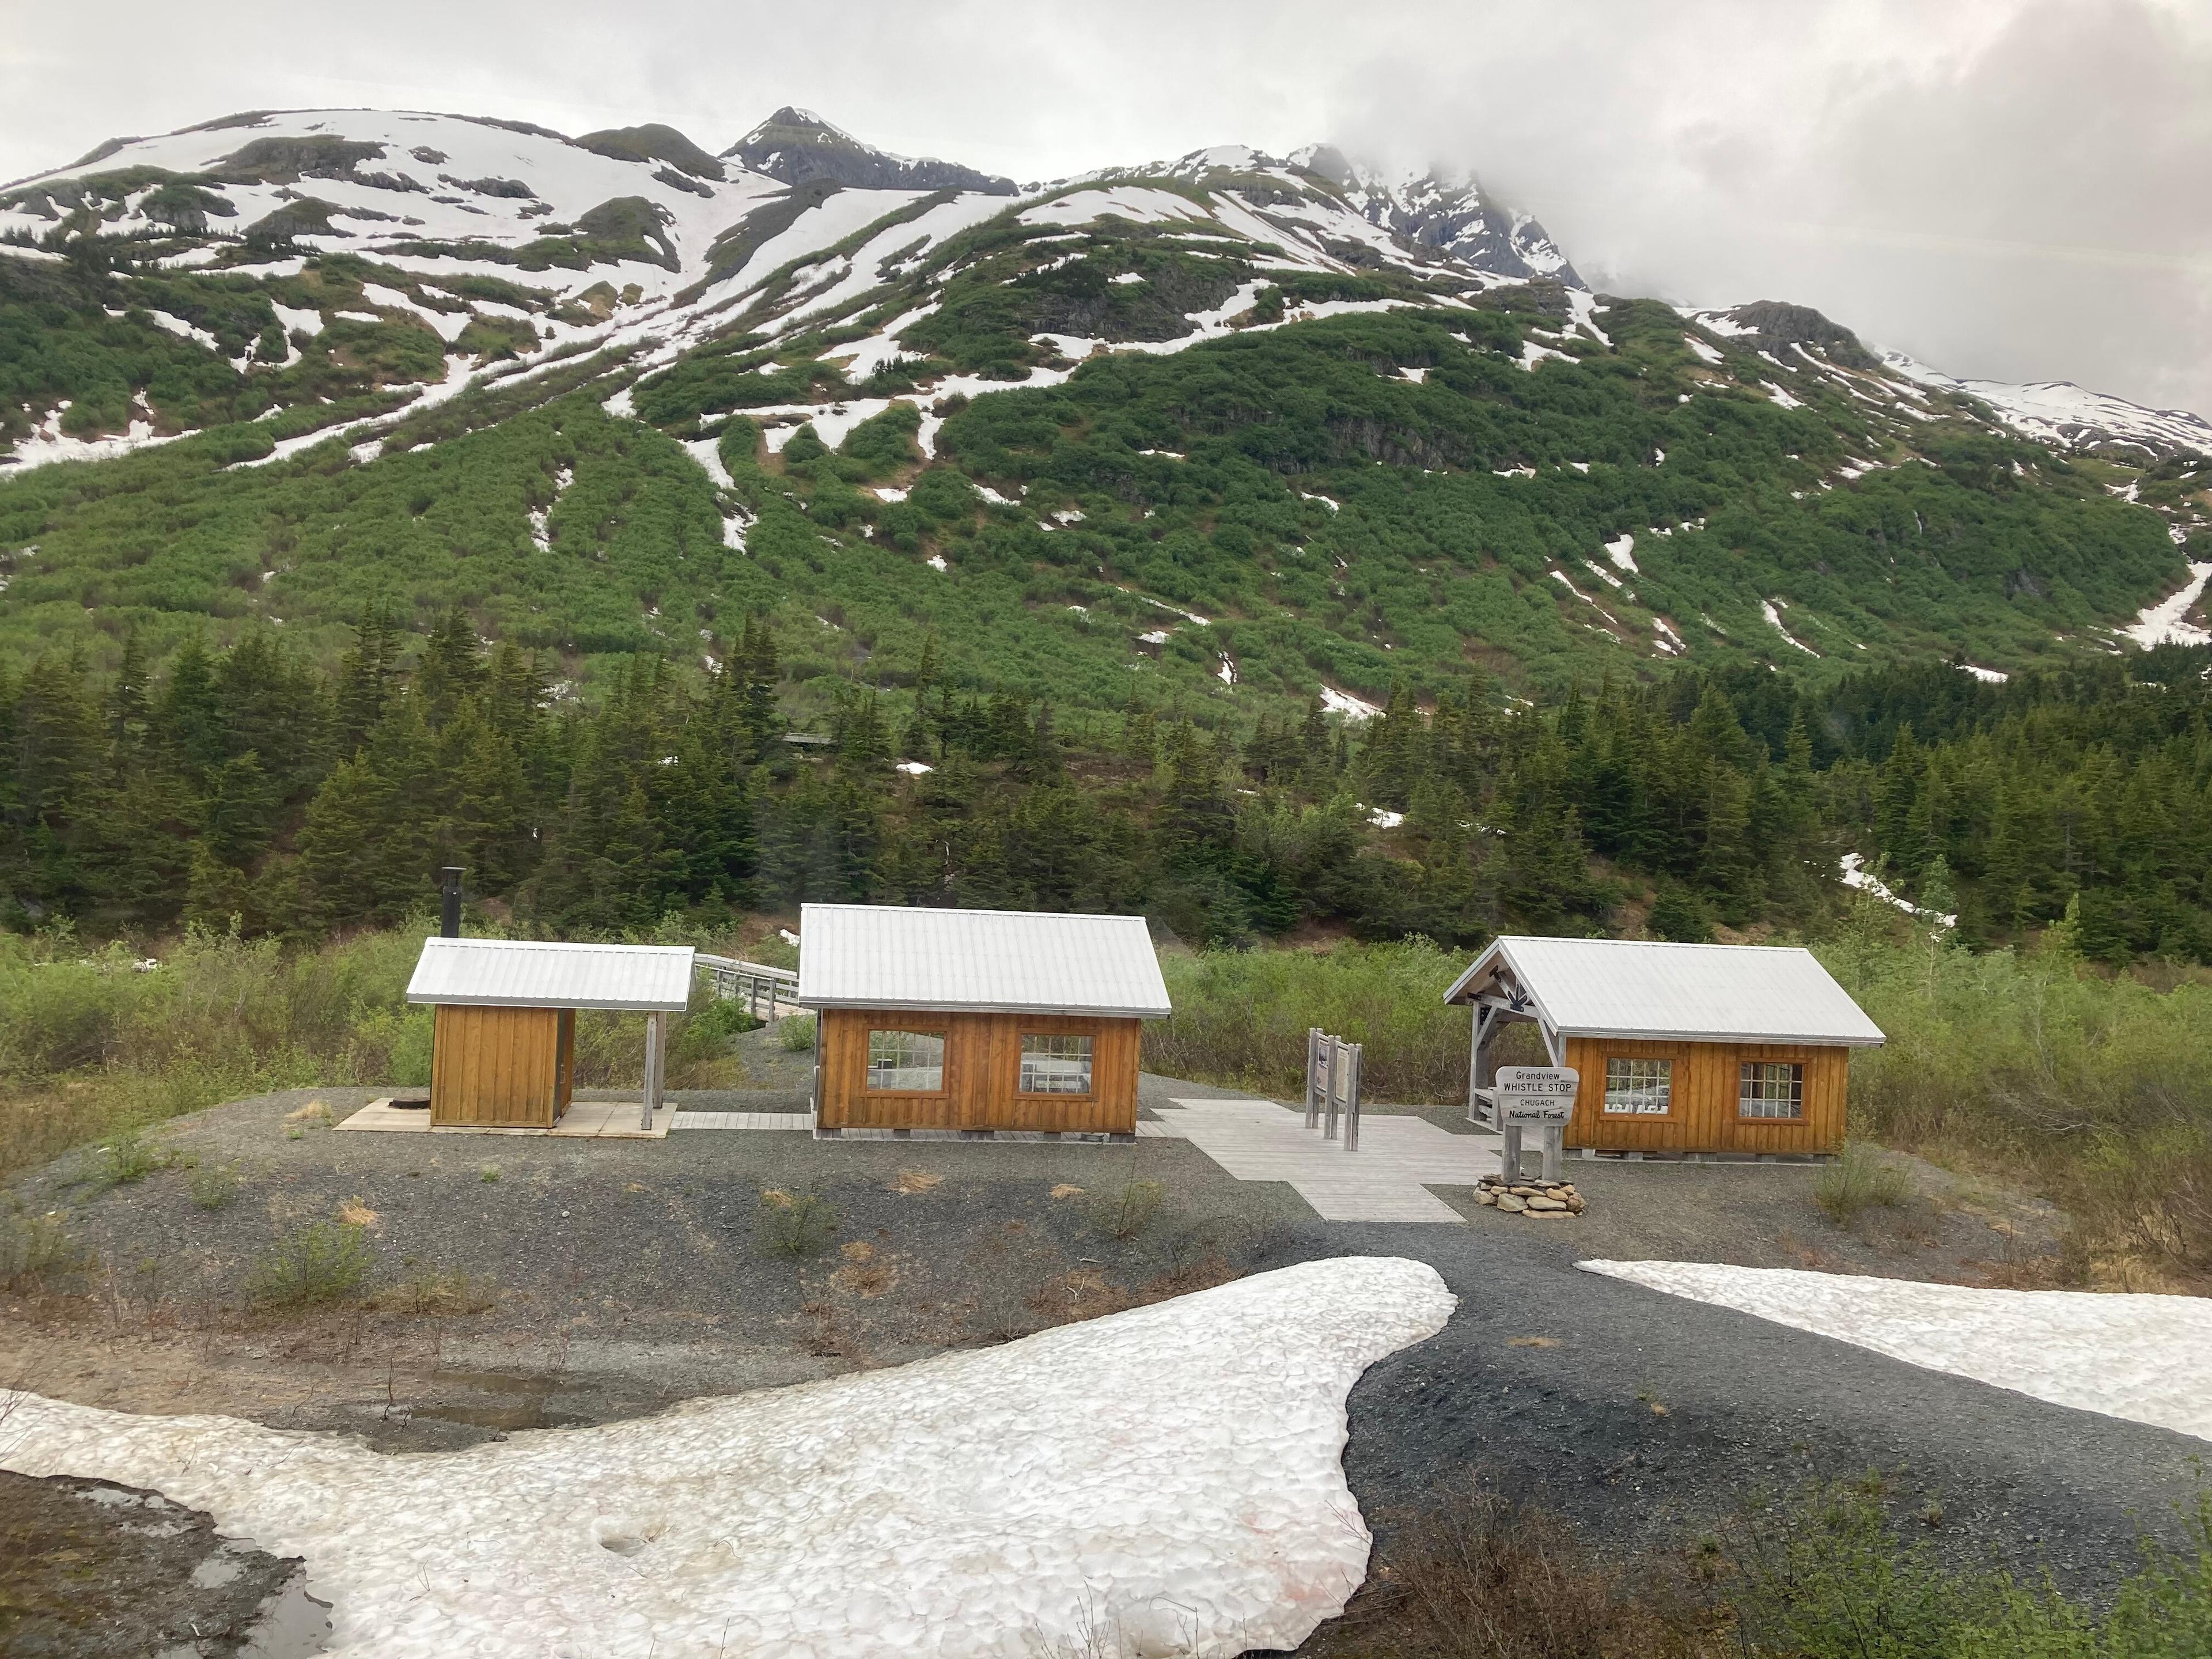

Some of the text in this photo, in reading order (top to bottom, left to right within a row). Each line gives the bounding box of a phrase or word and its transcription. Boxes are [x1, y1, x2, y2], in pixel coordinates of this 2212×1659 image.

[1516, 1071, 1560, 1080] Grandview
[1504, 1083, 1571, 1092] WHISTLE STOP
[1509, 1110, 1565, 1119] National Forest
